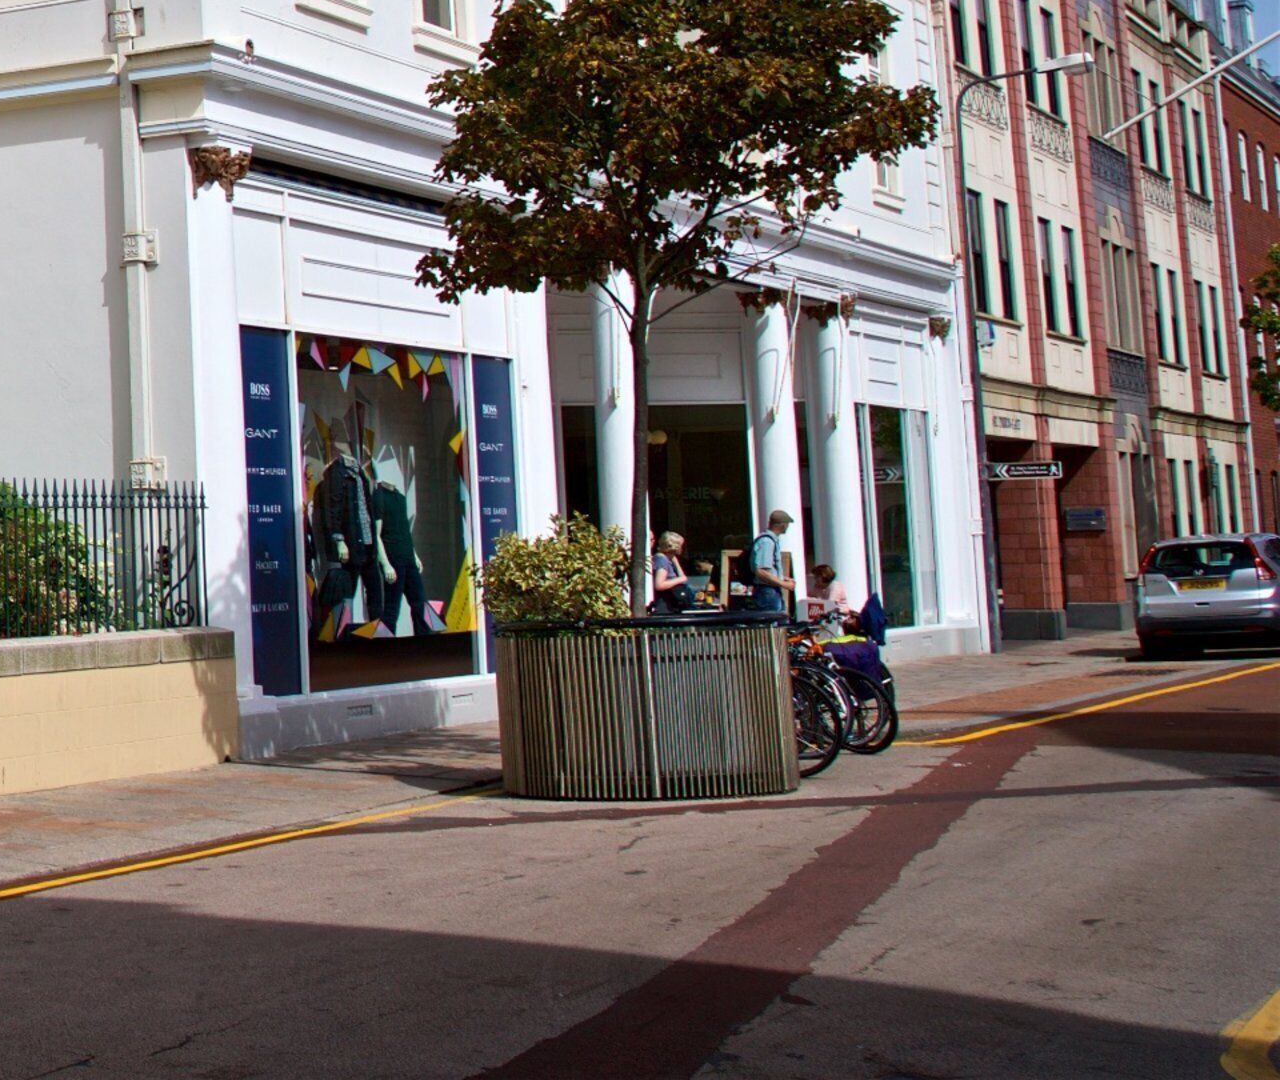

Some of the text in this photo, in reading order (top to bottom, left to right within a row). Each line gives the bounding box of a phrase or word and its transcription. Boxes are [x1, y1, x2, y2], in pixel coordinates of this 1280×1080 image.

[250, 382, 271, 396] BOSS
[482, 404, 497, 415] BOSS
[244, 427, 278, 439] GANT
[479, 442, 504, 452] GANT
[263, 504, 282, 513] BAKER
